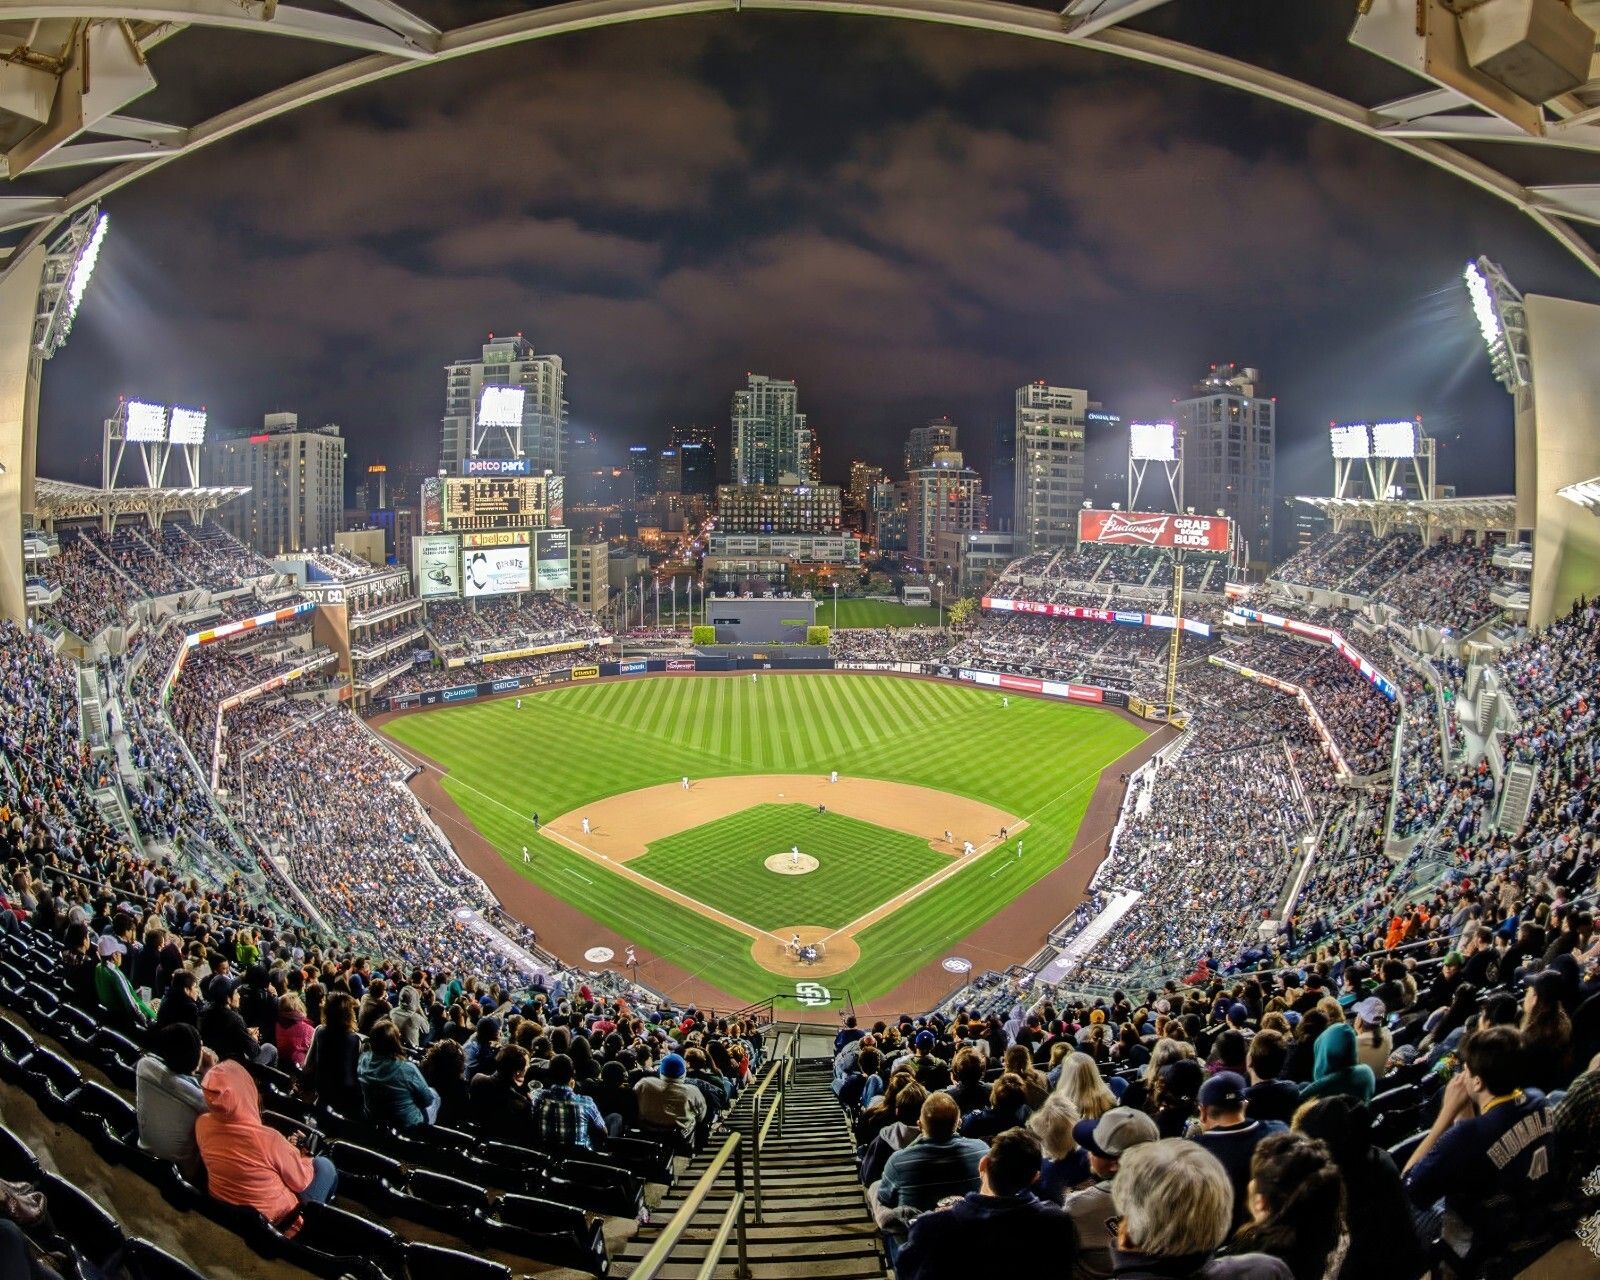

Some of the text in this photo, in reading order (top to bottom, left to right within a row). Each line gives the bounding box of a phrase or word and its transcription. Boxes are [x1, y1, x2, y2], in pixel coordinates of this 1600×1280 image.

[469, 460, 525, 472] petco park
[1099, 518, 1165, 534] Budweiser
[1174, 518, 1211, 530] GRAB
[1174, 534, 1210, 546] BUDS
[493, 680, 519, 690] GEICO
